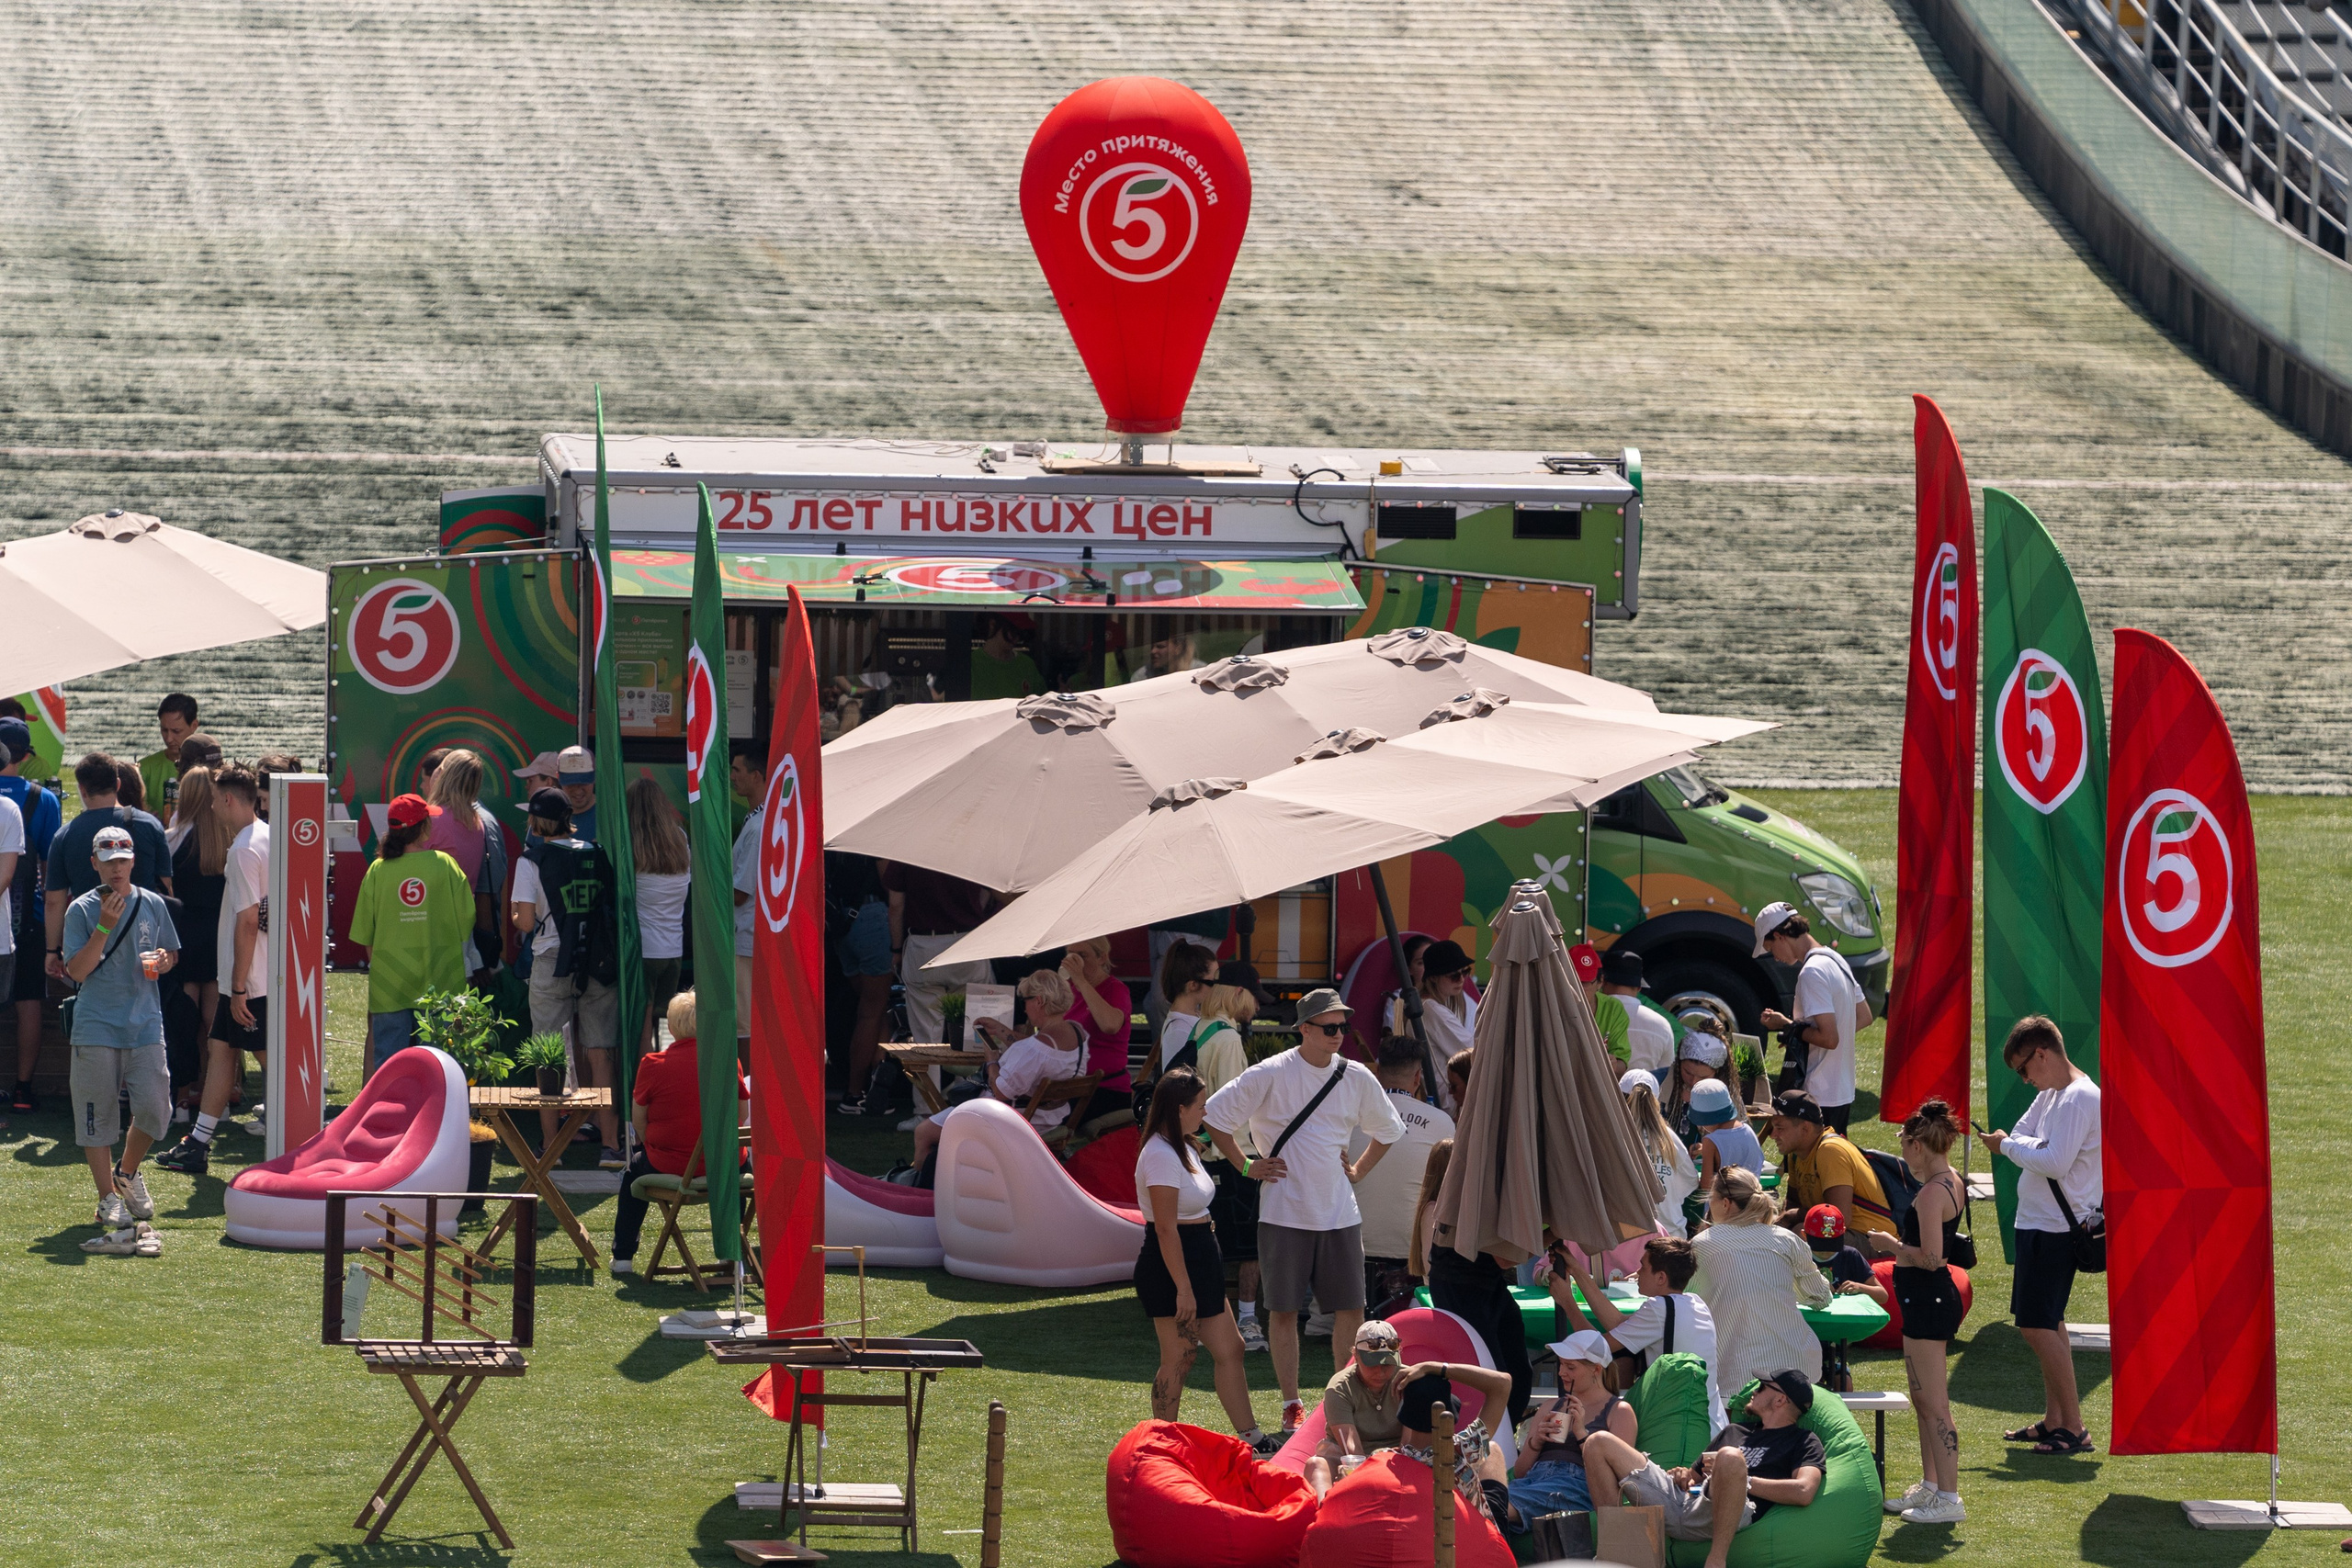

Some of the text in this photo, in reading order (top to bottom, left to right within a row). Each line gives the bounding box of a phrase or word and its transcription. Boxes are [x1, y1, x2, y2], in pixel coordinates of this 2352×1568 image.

[1054, 133, 1219, 215] Место притяжения
[1111, 173, 1174, 261] 5
[717, 490, 1213, 541] 25 лет низких цен
[935, 565, 1022, 589] 5
[376, 589, 438, 672] 5
[2024, 665, 2061, 783] 5
[299, 820, 313, 840] 5
[2143, 801, 2202, 932] 5
[406, 878, 422, 902] 5
